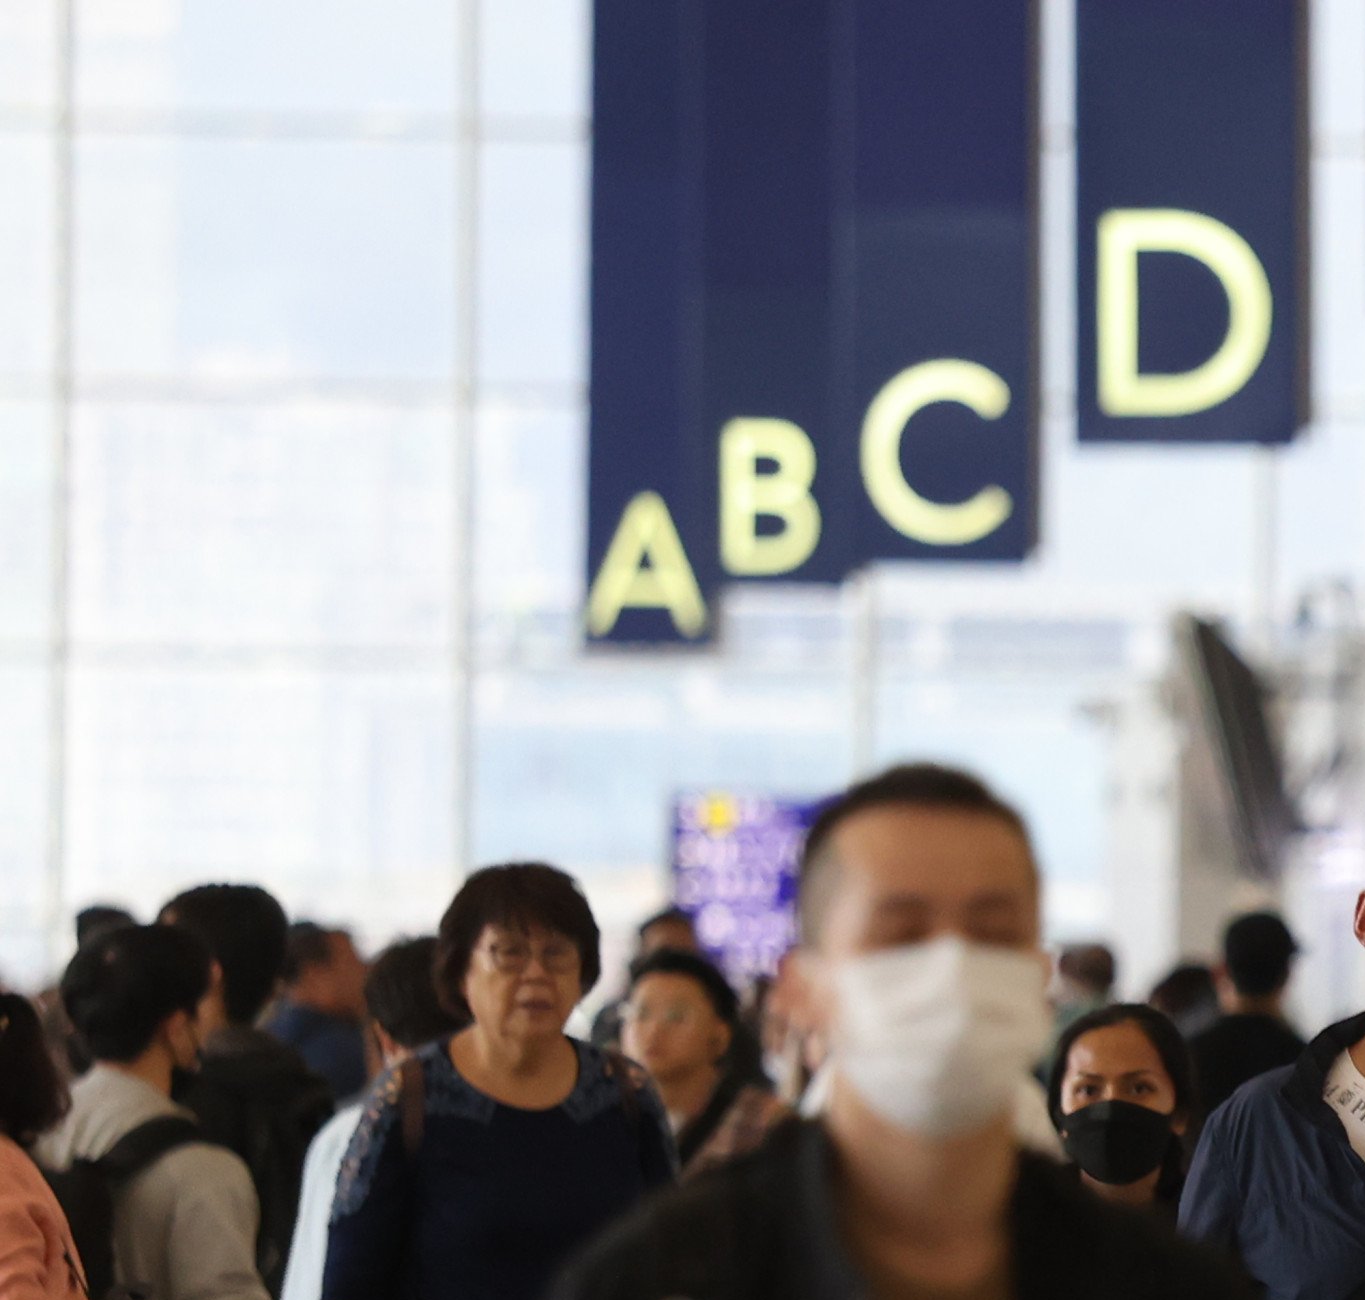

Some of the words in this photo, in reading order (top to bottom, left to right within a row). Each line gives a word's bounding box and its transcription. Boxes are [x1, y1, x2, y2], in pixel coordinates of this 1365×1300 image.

[1096, 207, 1274, 420] D
[718, 417, 822, 577] B
[859, 358, 1013, 546] C
[588, 490, 707, 639] A
